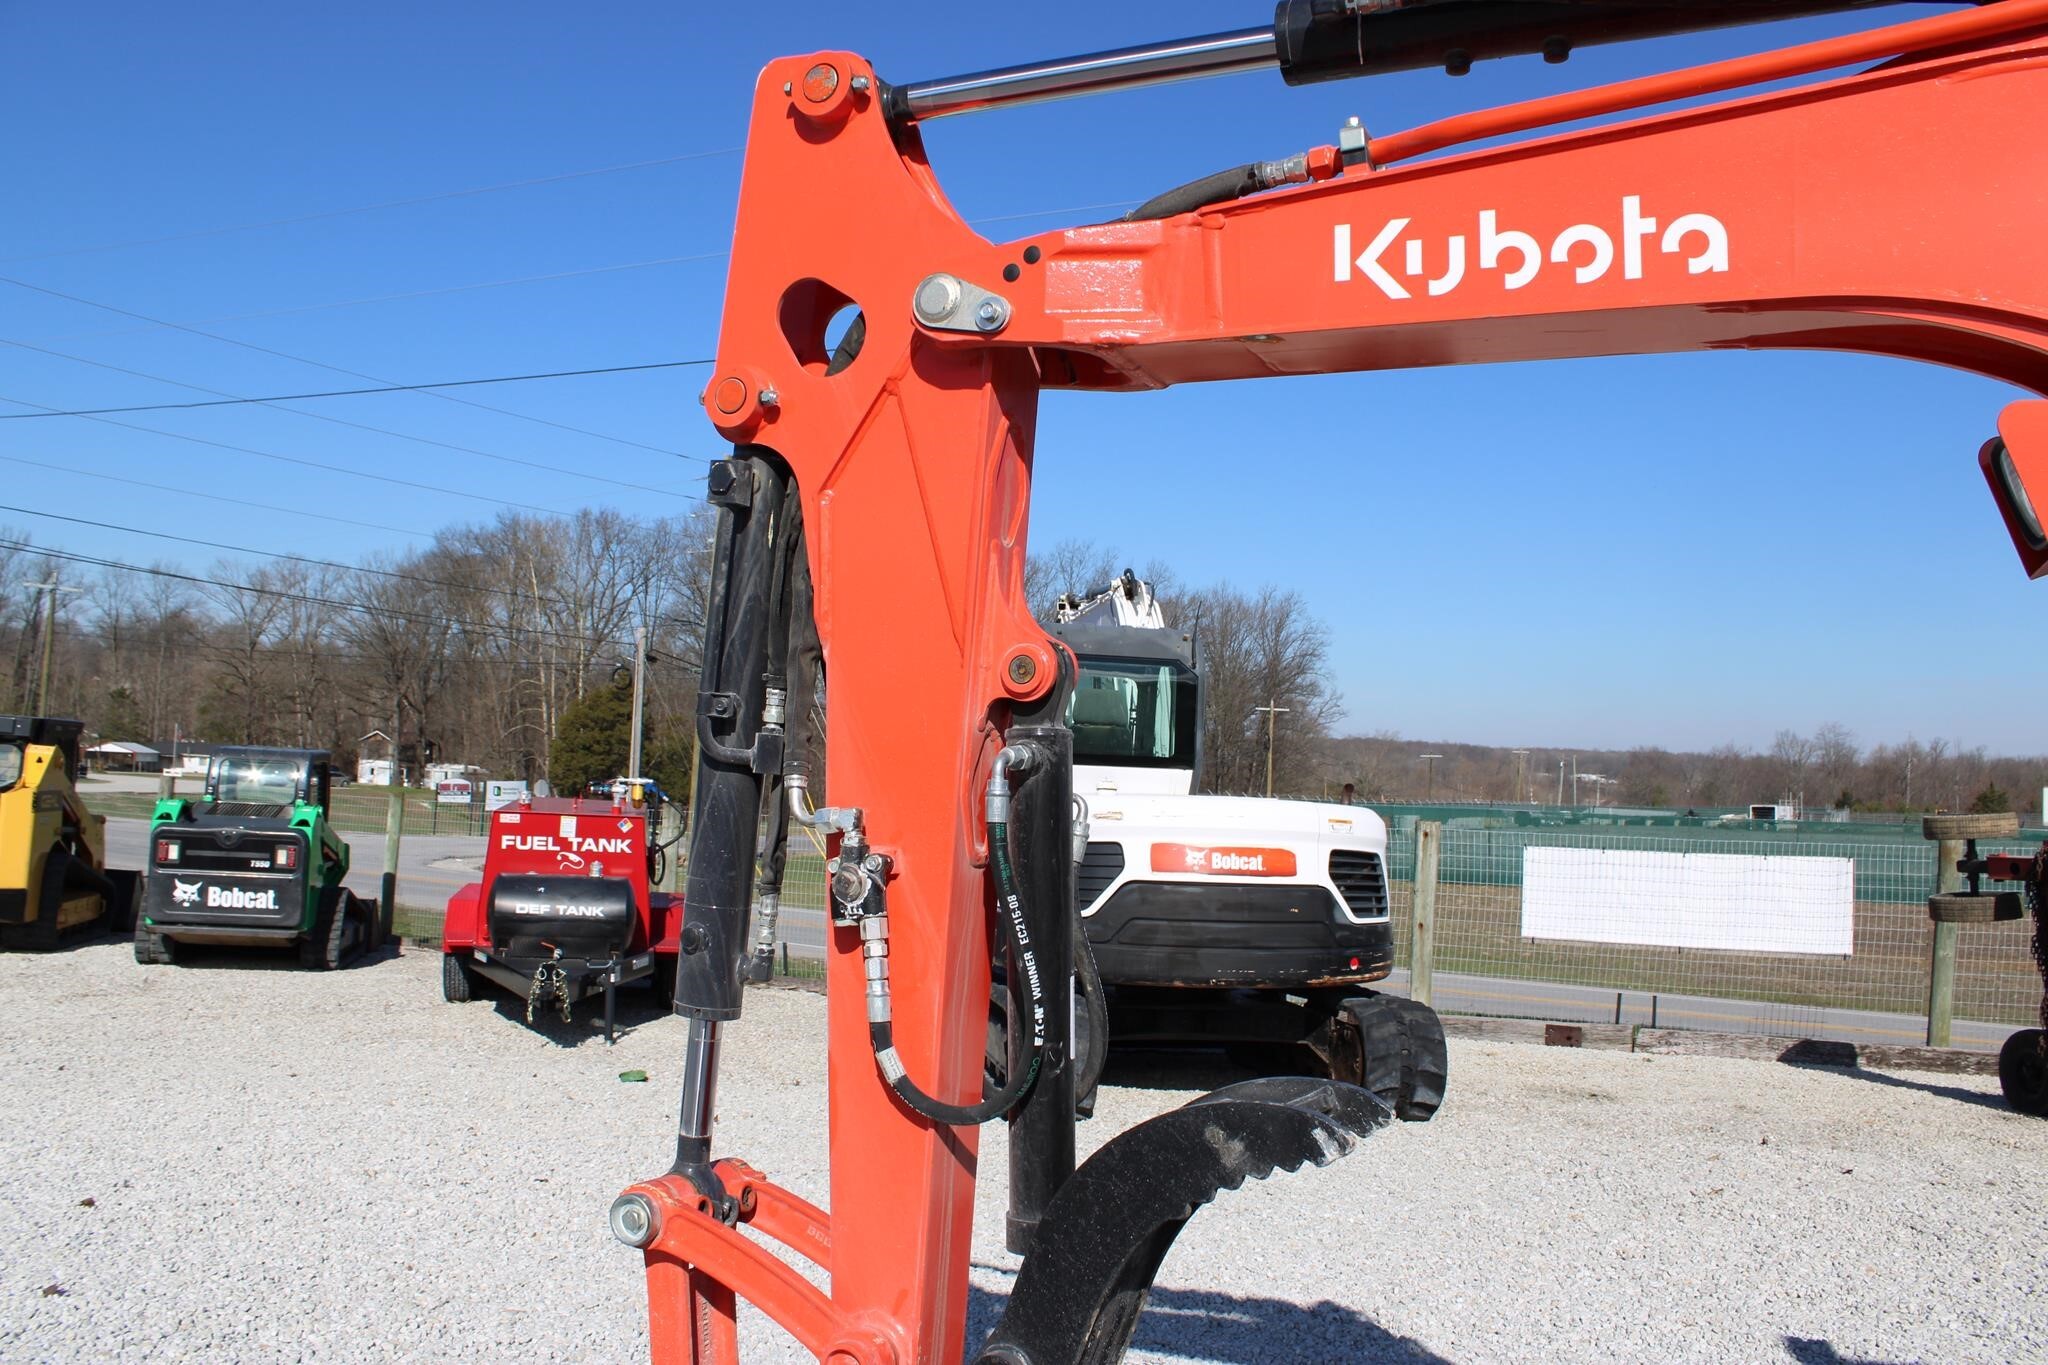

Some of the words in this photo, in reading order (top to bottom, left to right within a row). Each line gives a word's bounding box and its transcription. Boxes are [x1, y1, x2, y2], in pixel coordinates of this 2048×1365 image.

[1333, 195, 1729, 300] Kubota
[501, 835, 560, 851] FUEL
[568, 838, 632, 854] TANK
[515, 904, 550, 914] DEF
[556, 905, 604, 917] TANK
[1007, 894, 1030, 945] EC215-08
[1023, 951, 1041, 1000] WINNER
